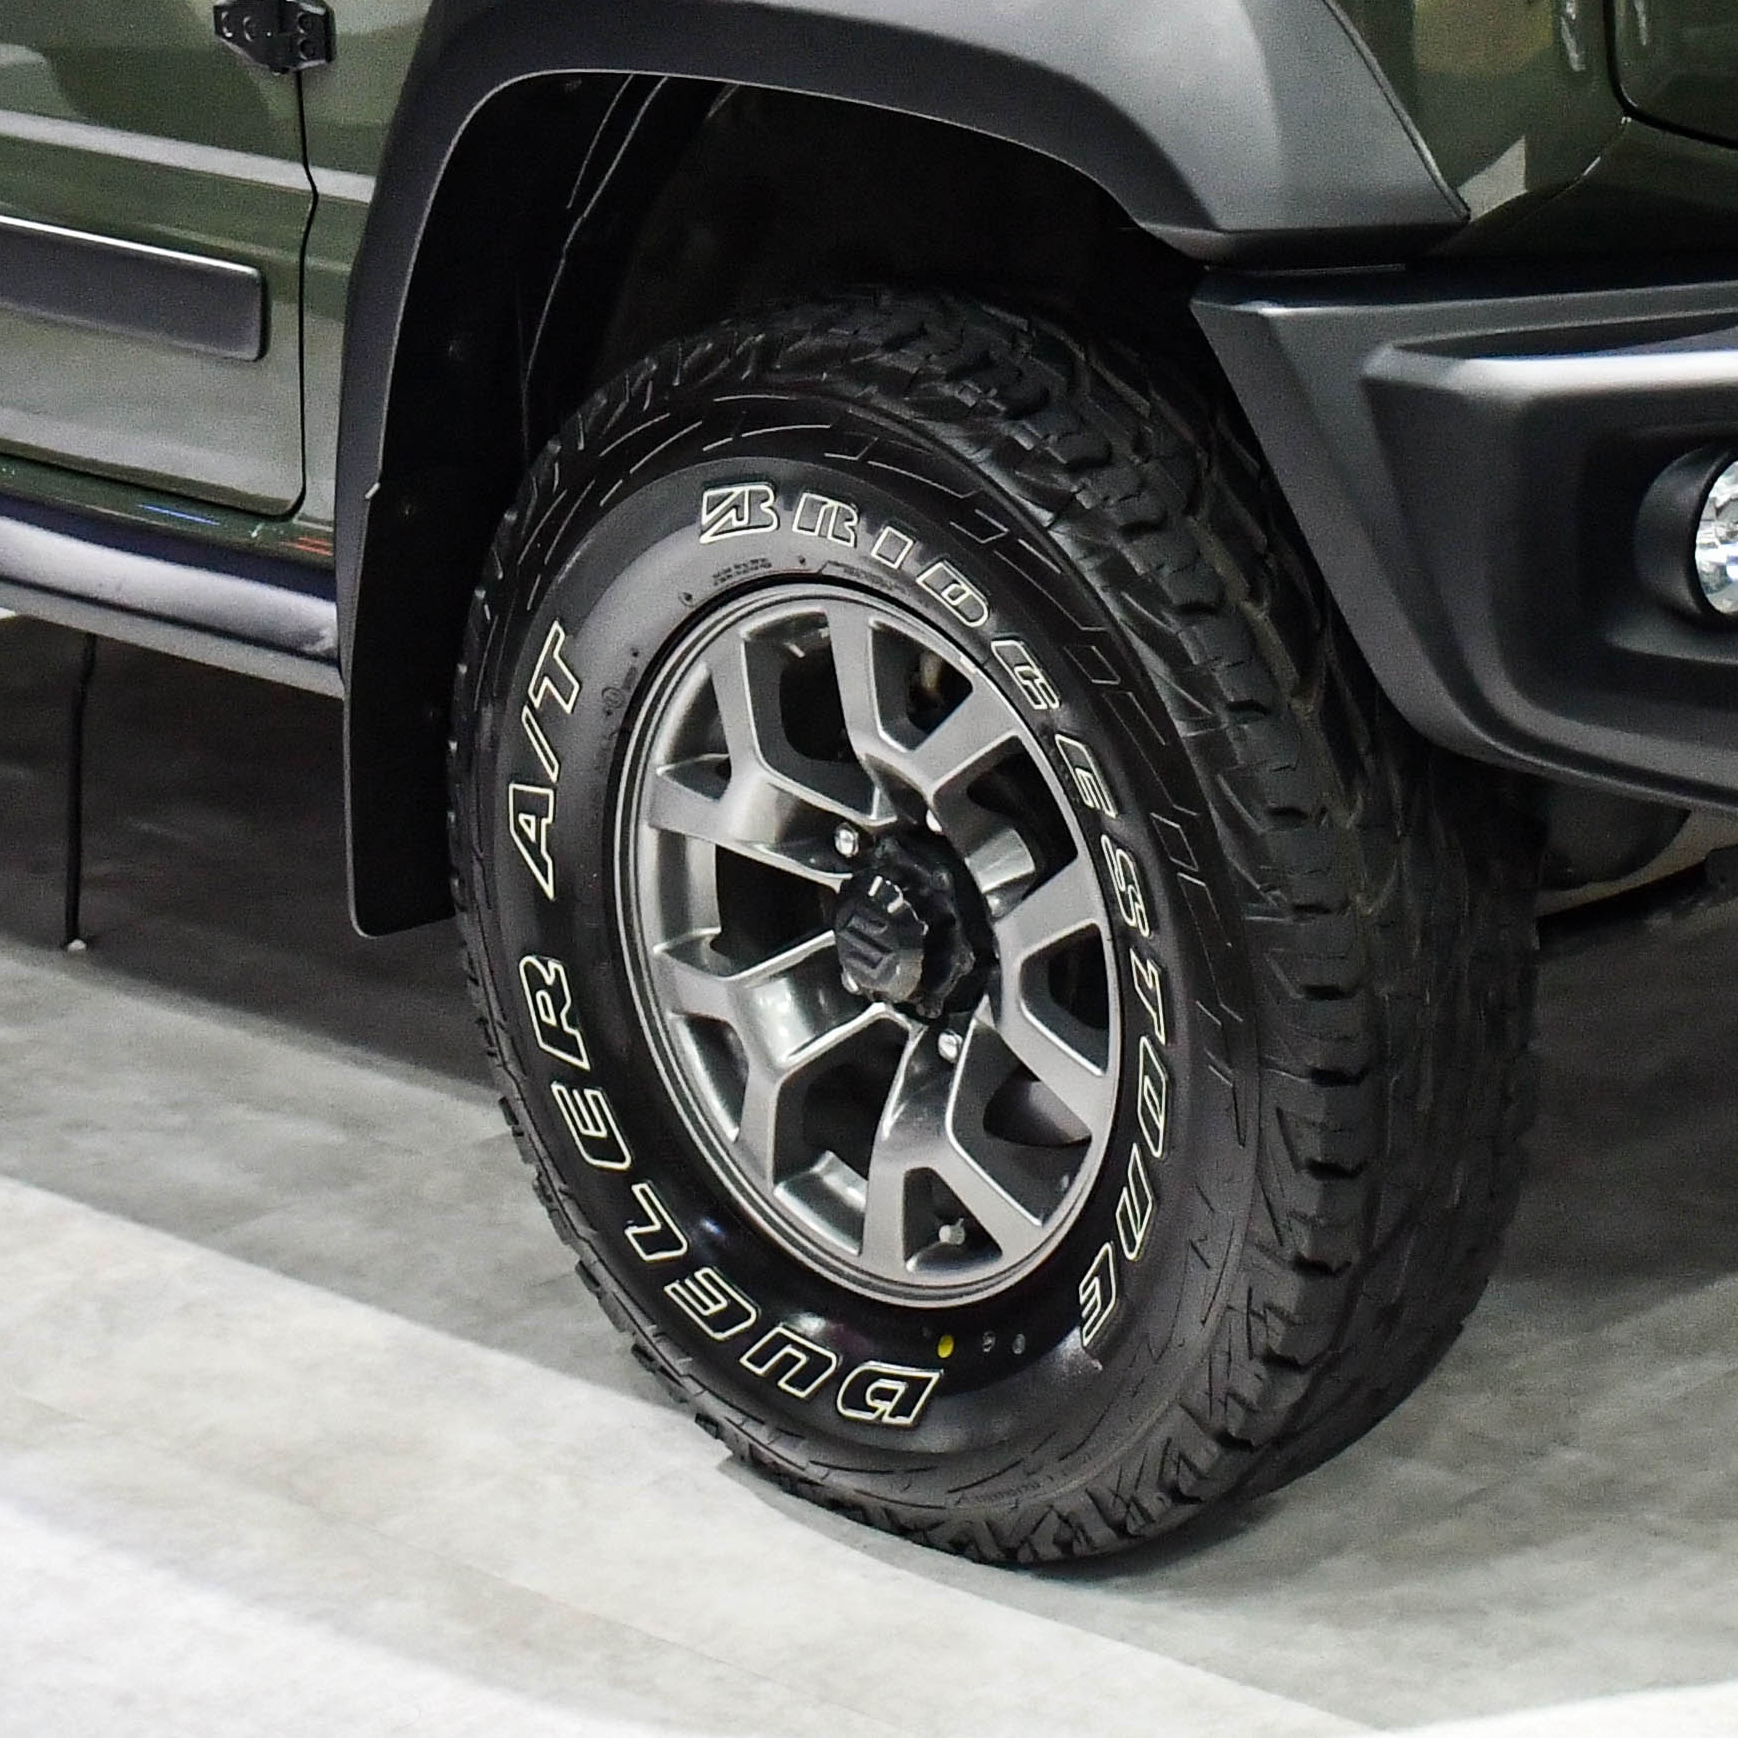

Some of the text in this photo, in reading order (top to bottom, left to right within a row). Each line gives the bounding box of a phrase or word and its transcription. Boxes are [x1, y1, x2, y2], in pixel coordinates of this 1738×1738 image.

[507, 621, 946, 1428] DUELER A/T
[699, 481, 1167, 1348] BRIDGESTONE
